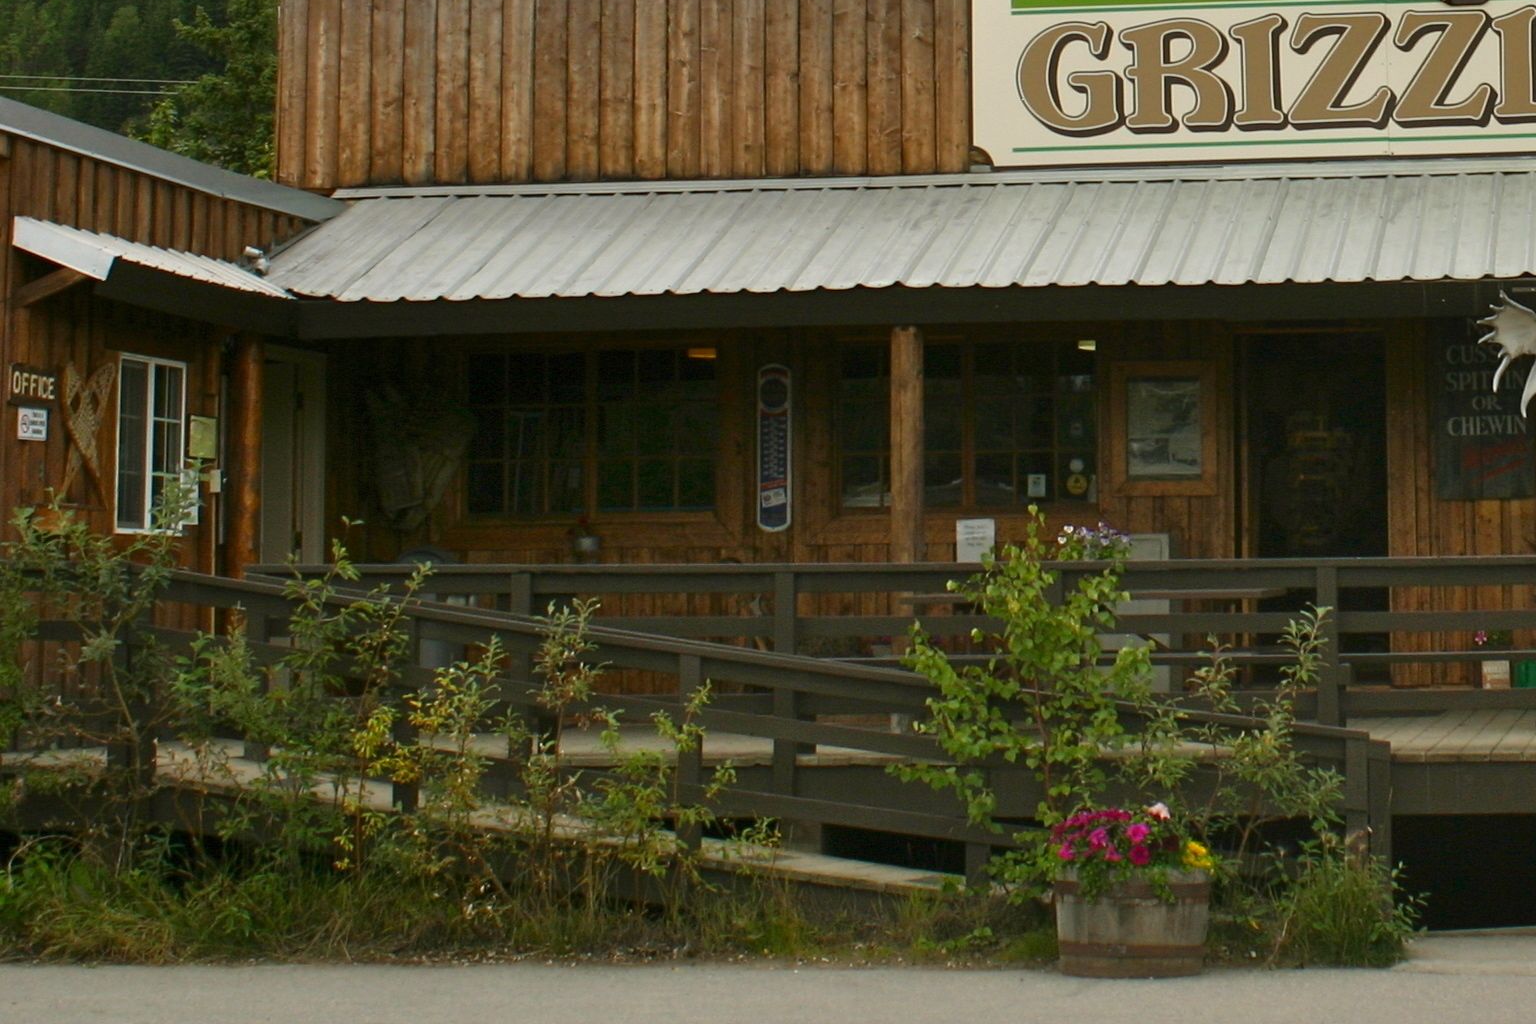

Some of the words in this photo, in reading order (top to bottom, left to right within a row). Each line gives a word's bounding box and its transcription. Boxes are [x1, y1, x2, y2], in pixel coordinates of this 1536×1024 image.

[13, 371, 56, 400] OFFICE
[1445, 370, 1527, 392] SPITIN
[1472, 394, 1503, 411] OR
[1447, 415, 1527, 437] CHEWIN
